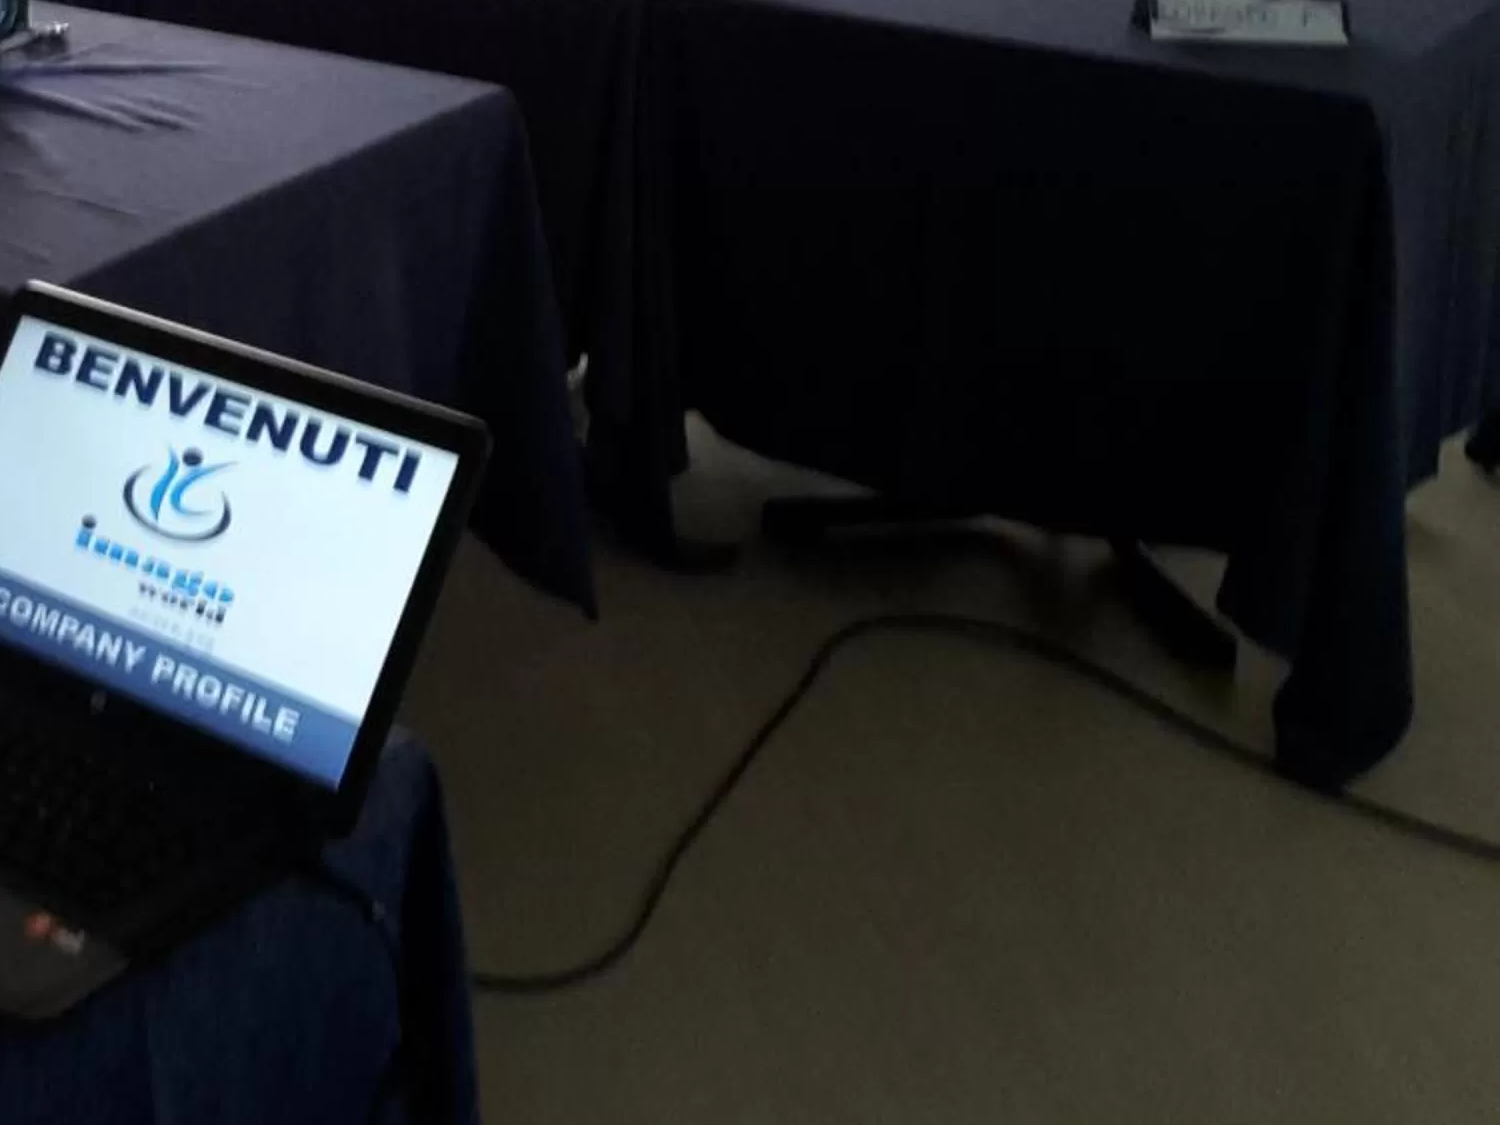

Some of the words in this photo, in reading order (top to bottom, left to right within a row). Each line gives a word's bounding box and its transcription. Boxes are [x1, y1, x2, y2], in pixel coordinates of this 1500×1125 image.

[32, 331, 422, 496] BENVENUTI
[75, 514, 235, 605] imago
[138, 580, 227, 625] world
[151, 654, 300, 743] PROFILE
